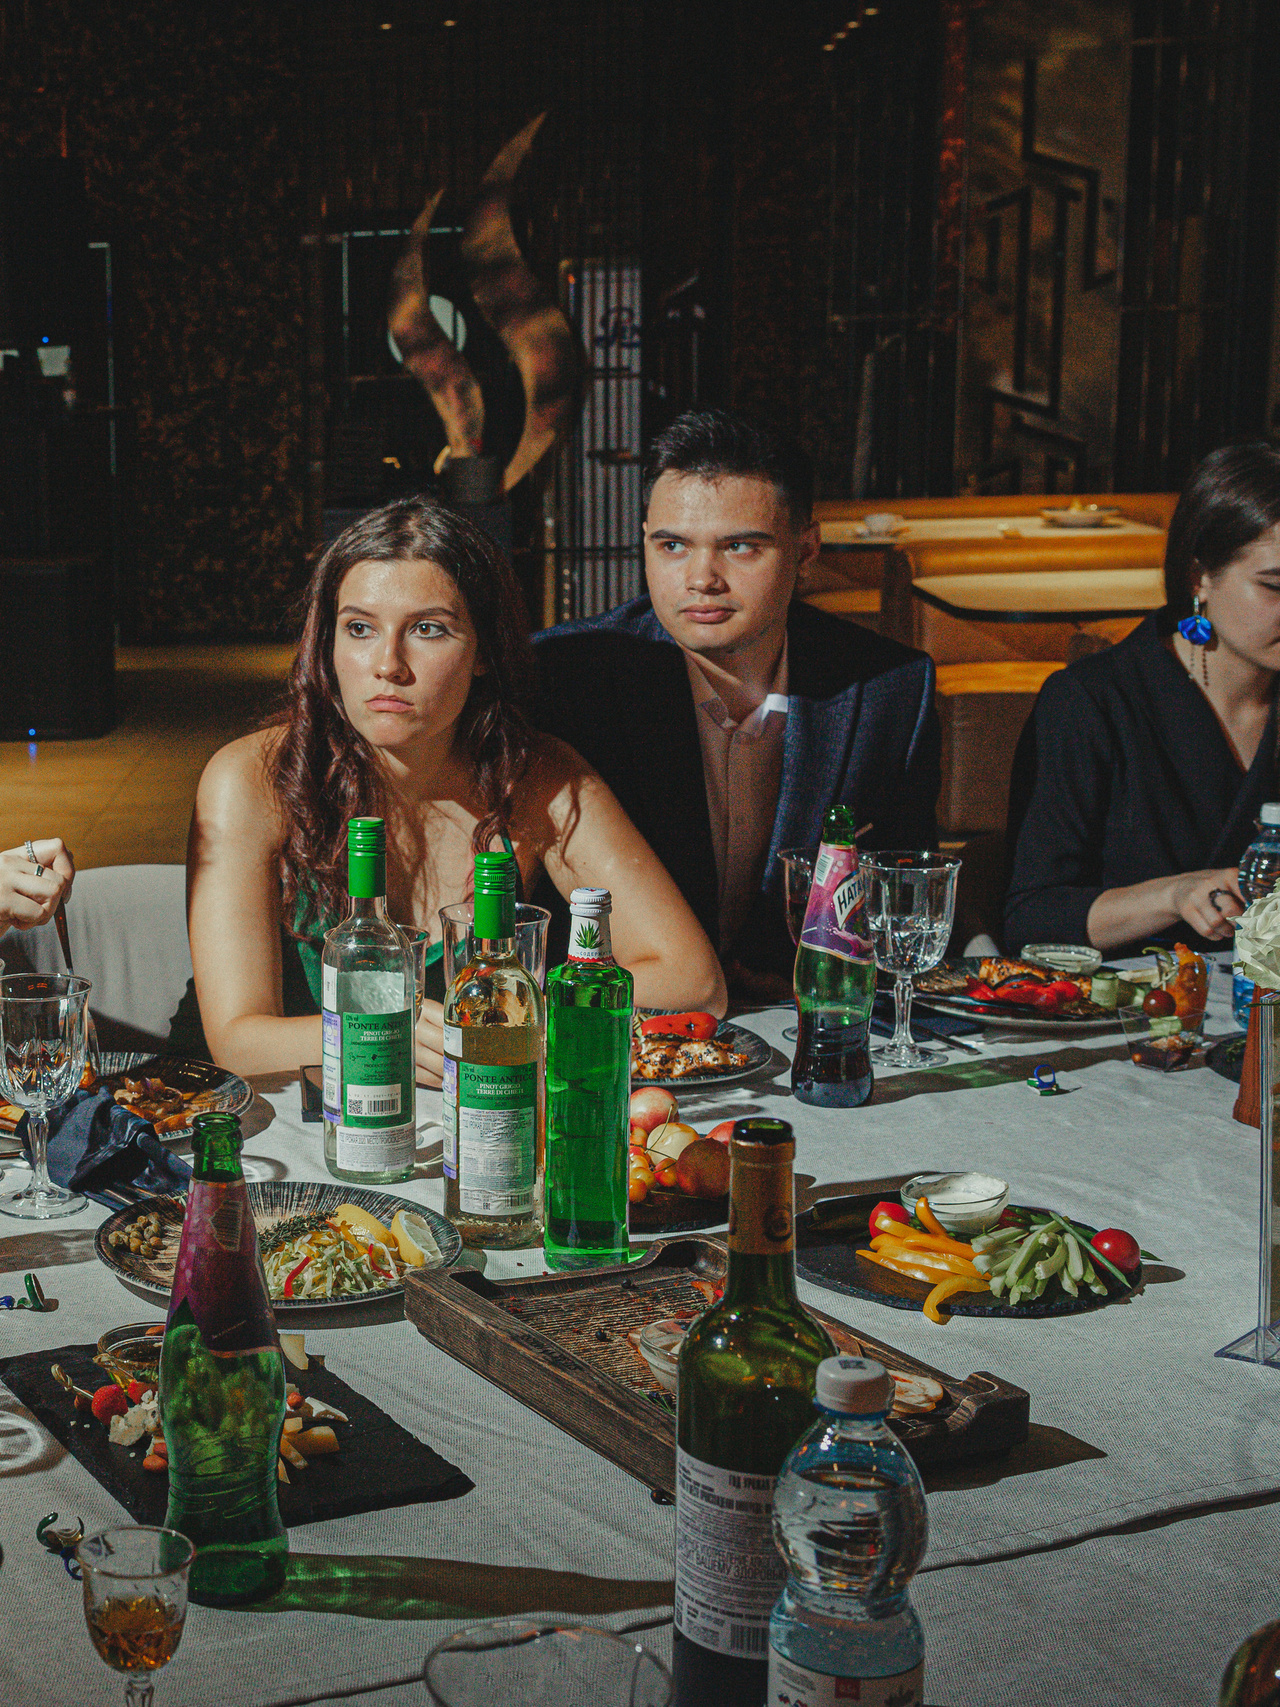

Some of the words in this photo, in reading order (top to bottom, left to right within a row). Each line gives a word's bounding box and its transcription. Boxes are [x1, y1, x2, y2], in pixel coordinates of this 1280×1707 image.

[348, 1022, 380, 1030] PONTE
[464, 1073, 497, 1083] PONTE
[498, 1072, 535, 1083] ANTICO
